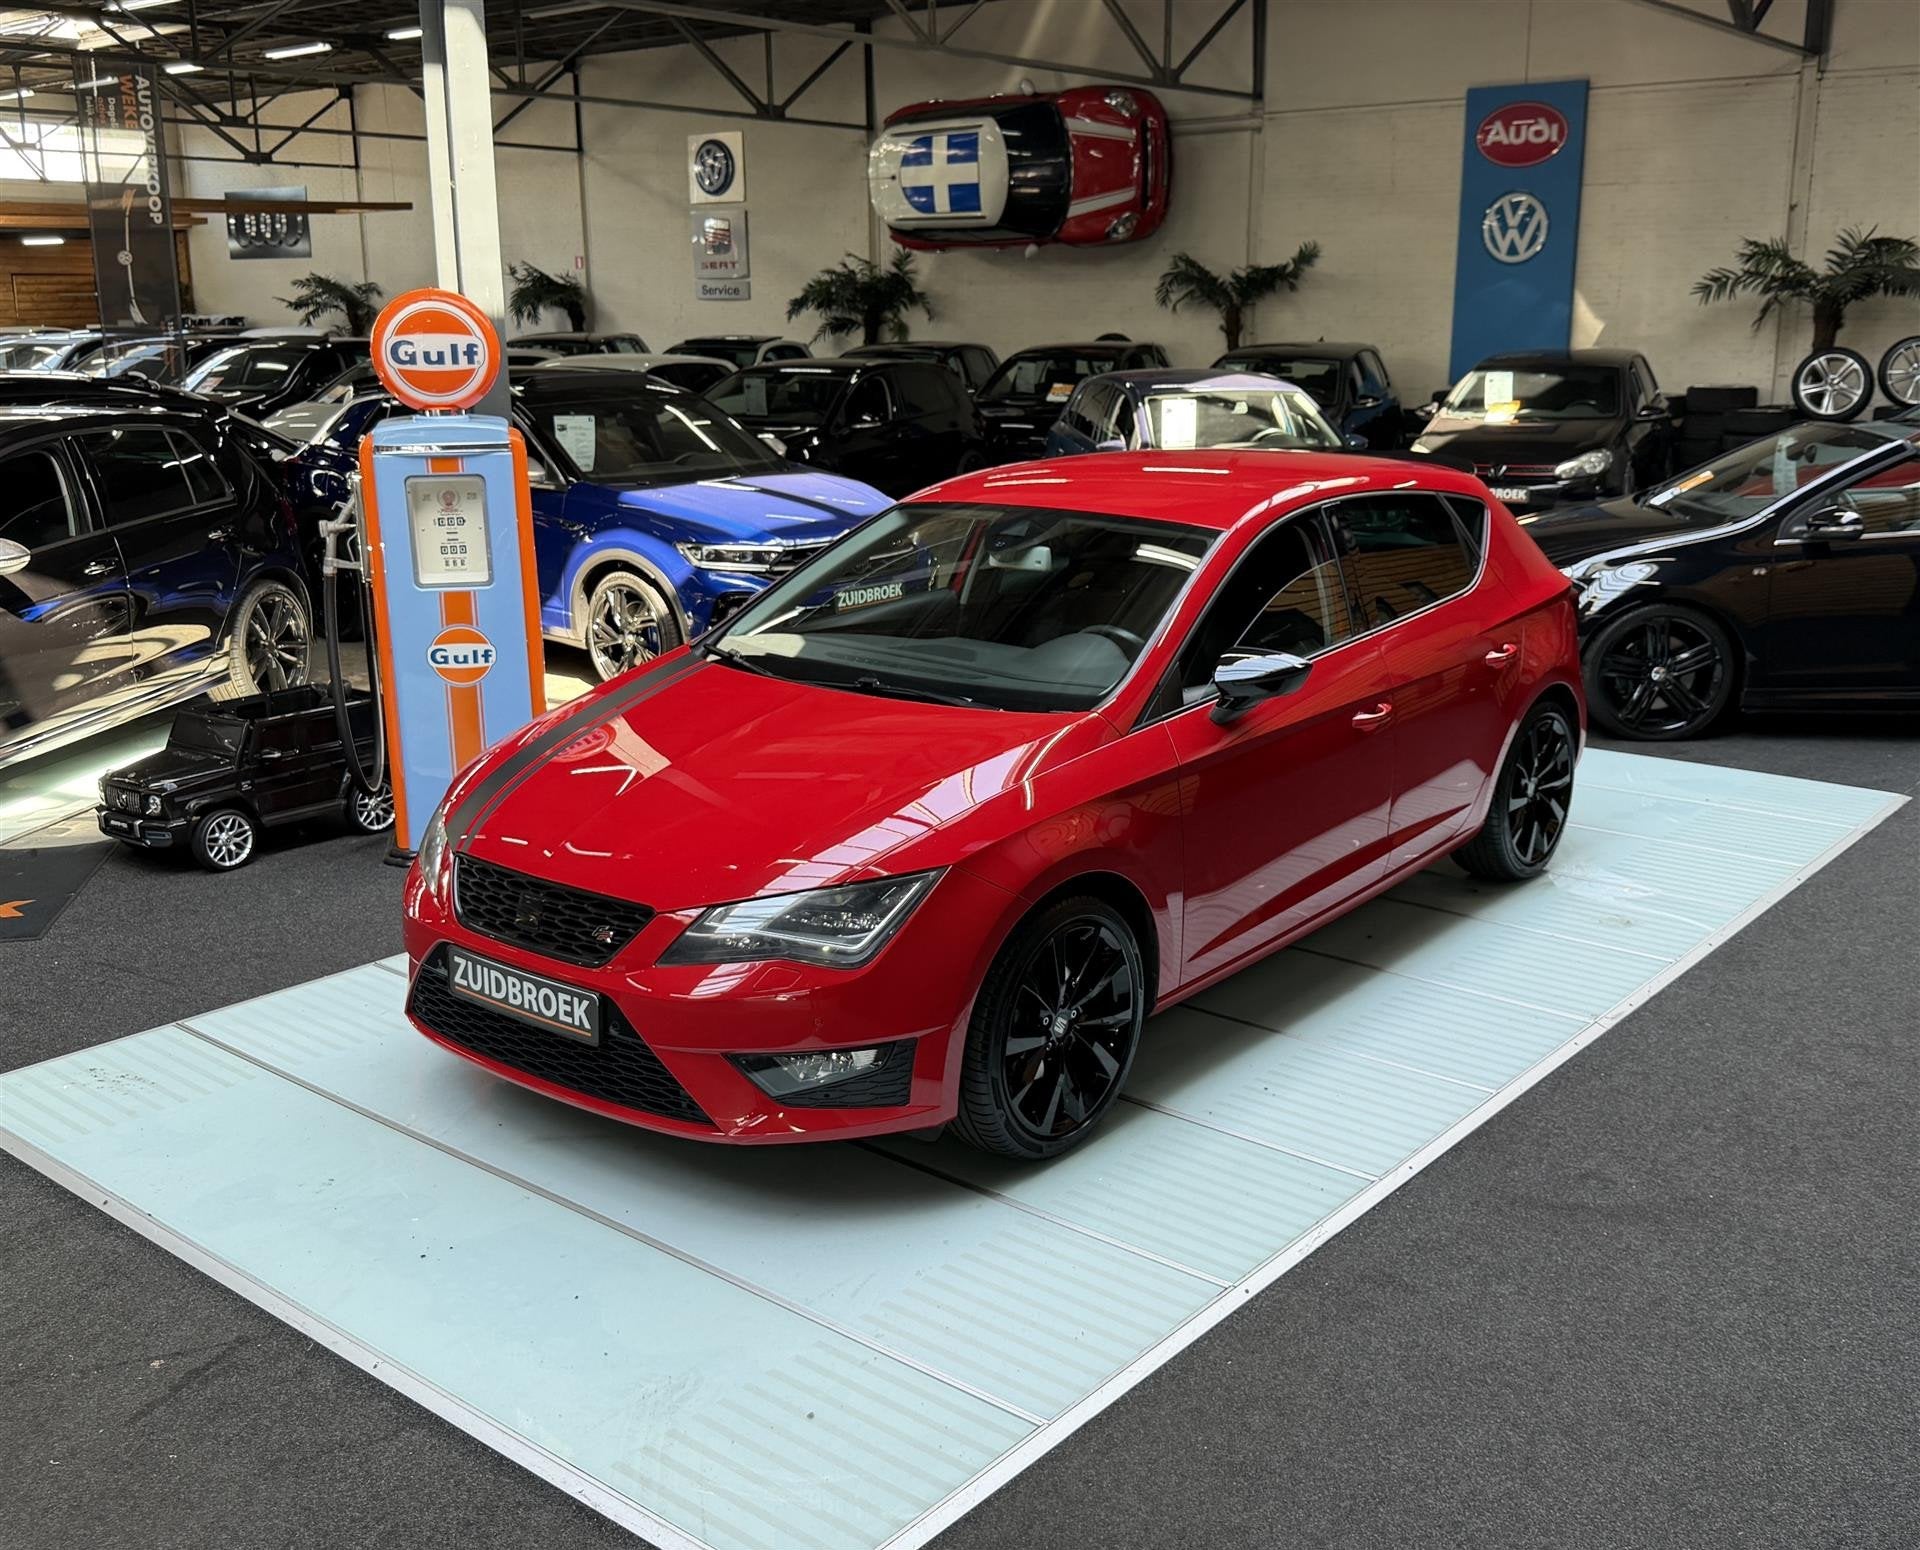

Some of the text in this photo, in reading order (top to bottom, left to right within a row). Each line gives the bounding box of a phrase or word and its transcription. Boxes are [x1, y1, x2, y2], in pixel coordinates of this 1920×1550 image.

[702, 285, 740, 297] Service
[390, 340, 479, 366] Gulf
[838, 583, 902, 608] ZUIDBROEK
[430, 648, 493, 664] Gulf
[454, 955, 591, 1030] ZUIDBROEK
